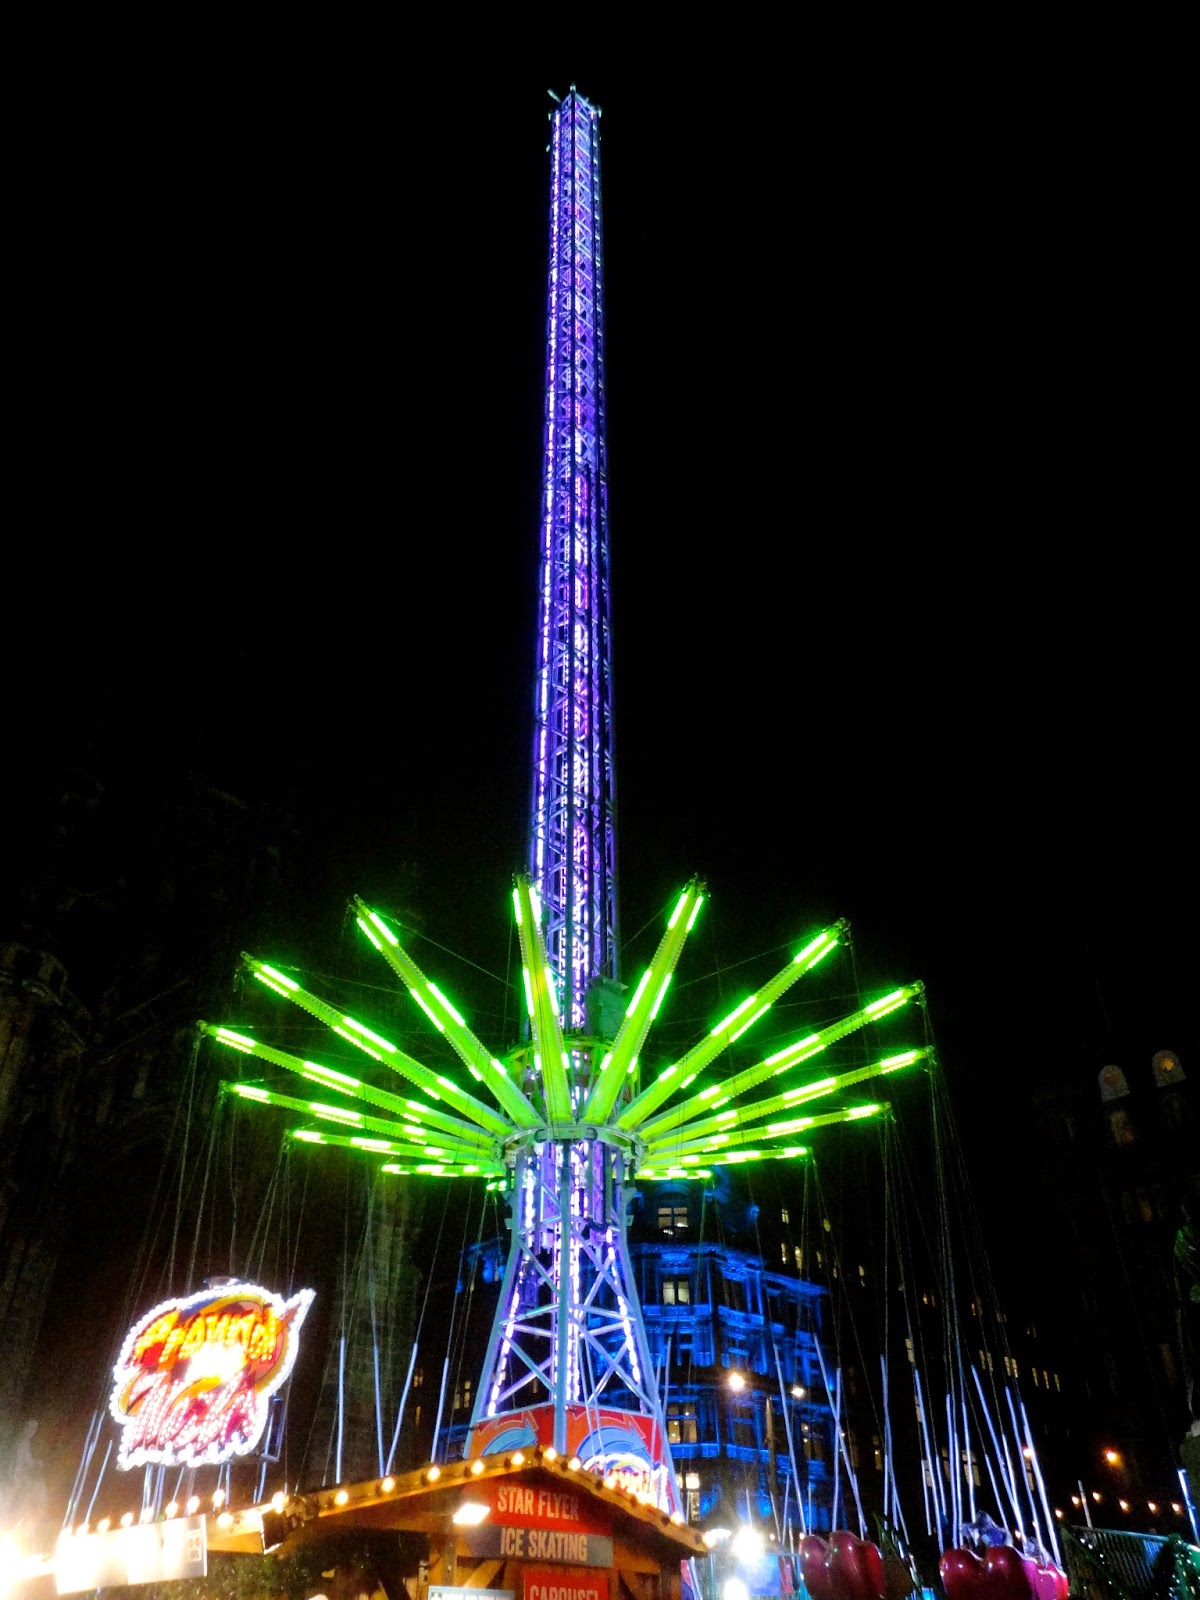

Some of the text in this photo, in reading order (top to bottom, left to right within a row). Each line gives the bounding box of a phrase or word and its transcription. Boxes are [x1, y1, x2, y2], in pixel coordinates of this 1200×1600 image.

[497, 1485, 579, 1520] STAR FLYER
[500, 1527, 588, 1561] ICE SKATING
